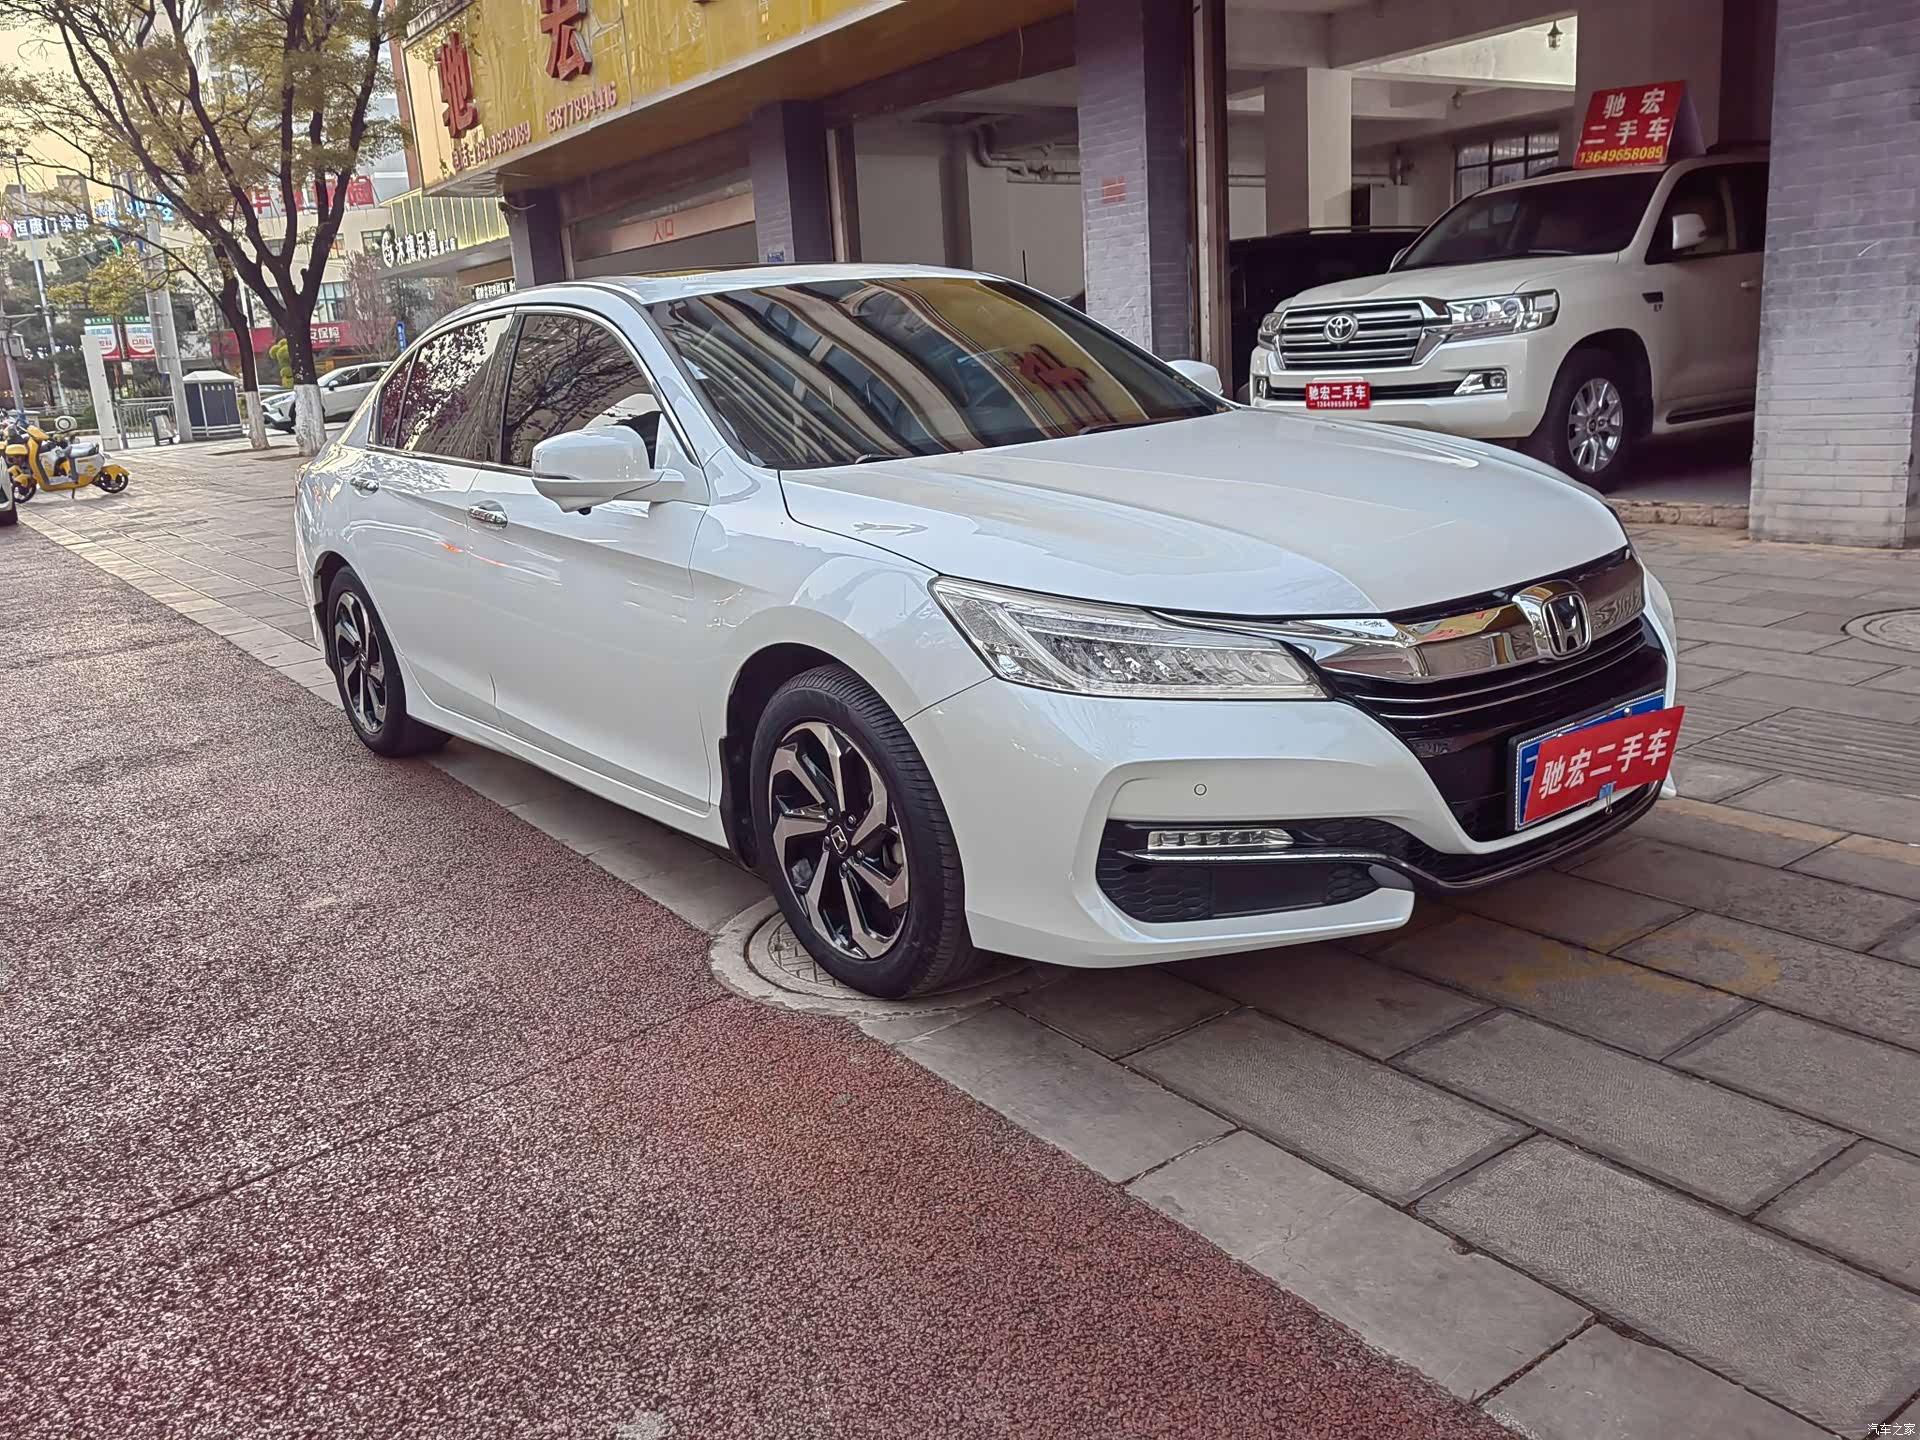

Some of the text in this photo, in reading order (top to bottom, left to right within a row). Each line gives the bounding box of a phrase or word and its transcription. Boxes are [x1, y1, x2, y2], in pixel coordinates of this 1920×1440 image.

[1602, 87, 1666, 120] 驰宏
[1583, 116, 1671, 146] 二手车
[1579, 145, 1664, 164] 13649658089
[653, 219, 674, 242] 入口
[1308, 384, 1367, 401] 驰宏二手车
[1539, 728, 1671, 800] 驰宏二手车
